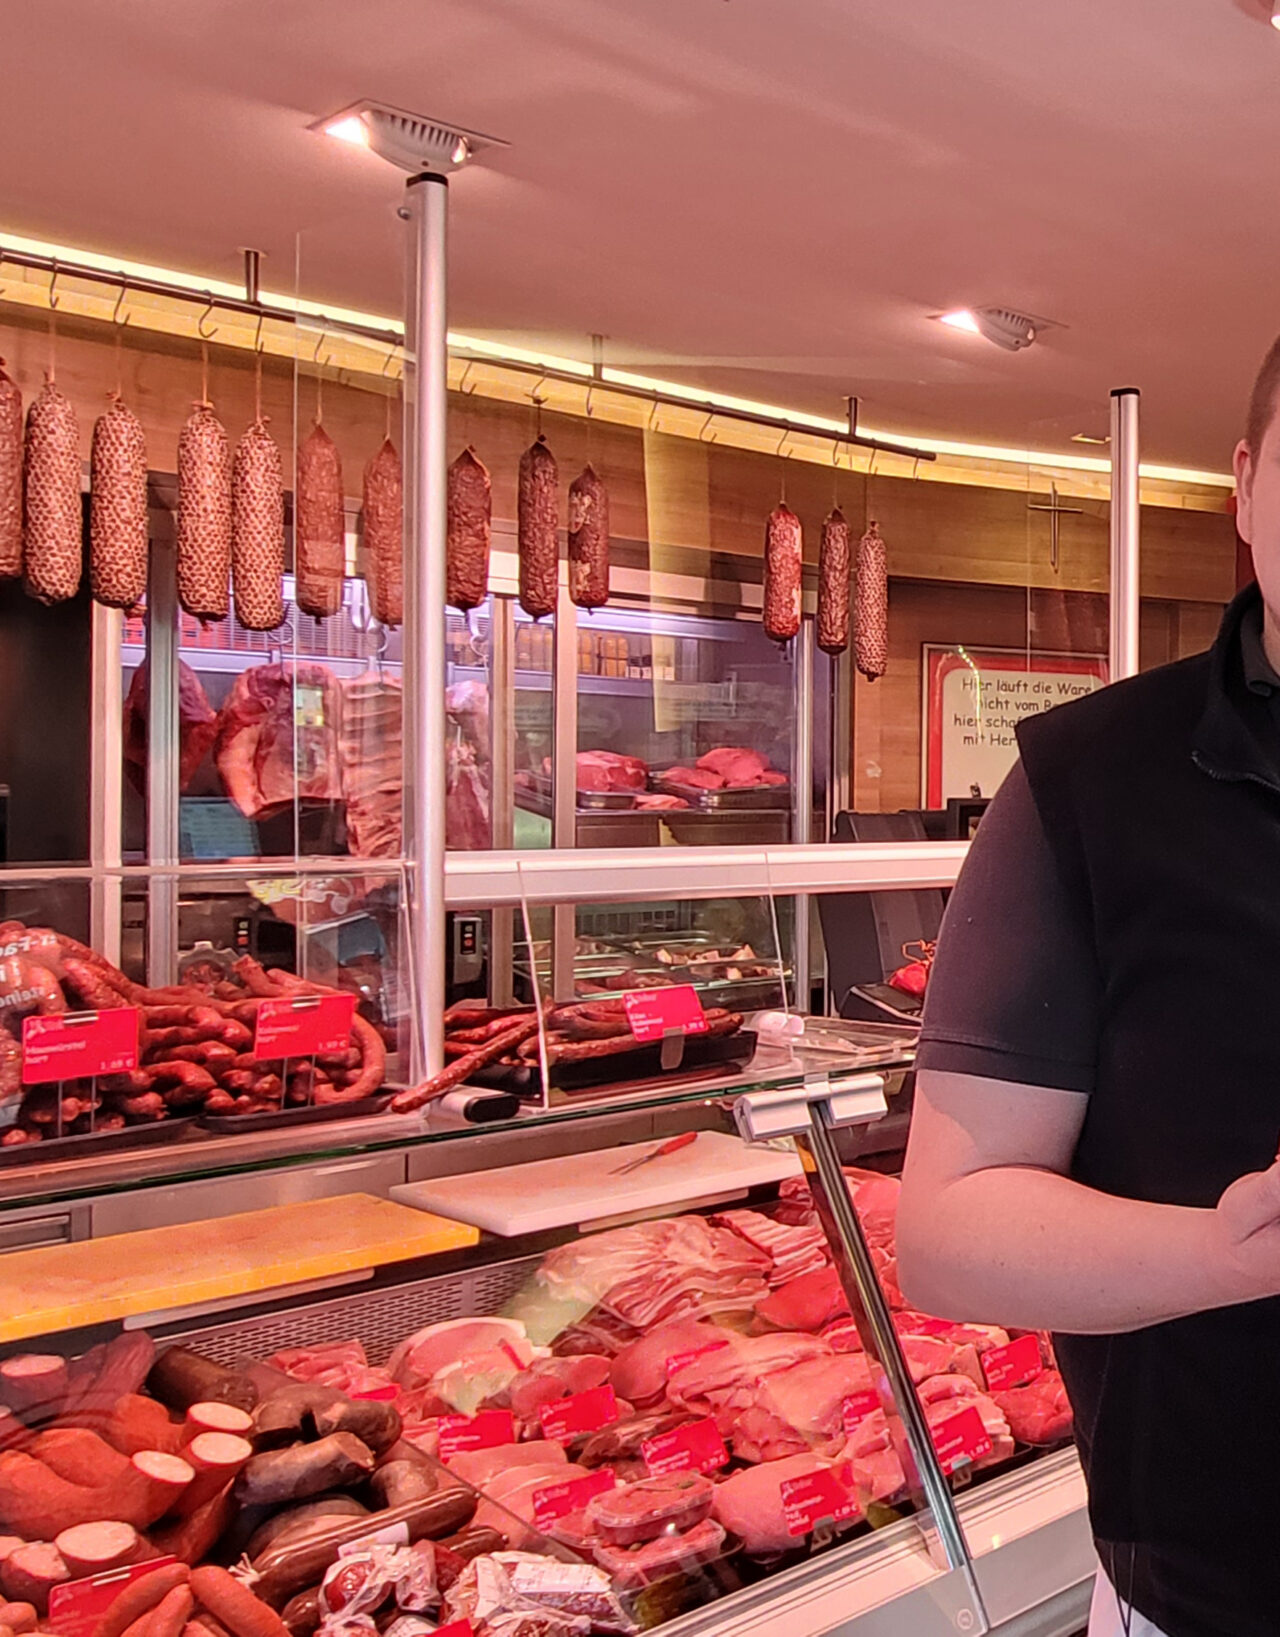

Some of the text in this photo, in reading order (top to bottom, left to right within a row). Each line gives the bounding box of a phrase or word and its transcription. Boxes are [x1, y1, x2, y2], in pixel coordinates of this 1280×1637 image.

[997, 679, 1028, 693] läuft
[1032, 681, 1053, 694] die
[1057, 682, 1092, 696] Ware
[1014, 701, 1039, 712] vom
[953, 714, 981, 727] hier
